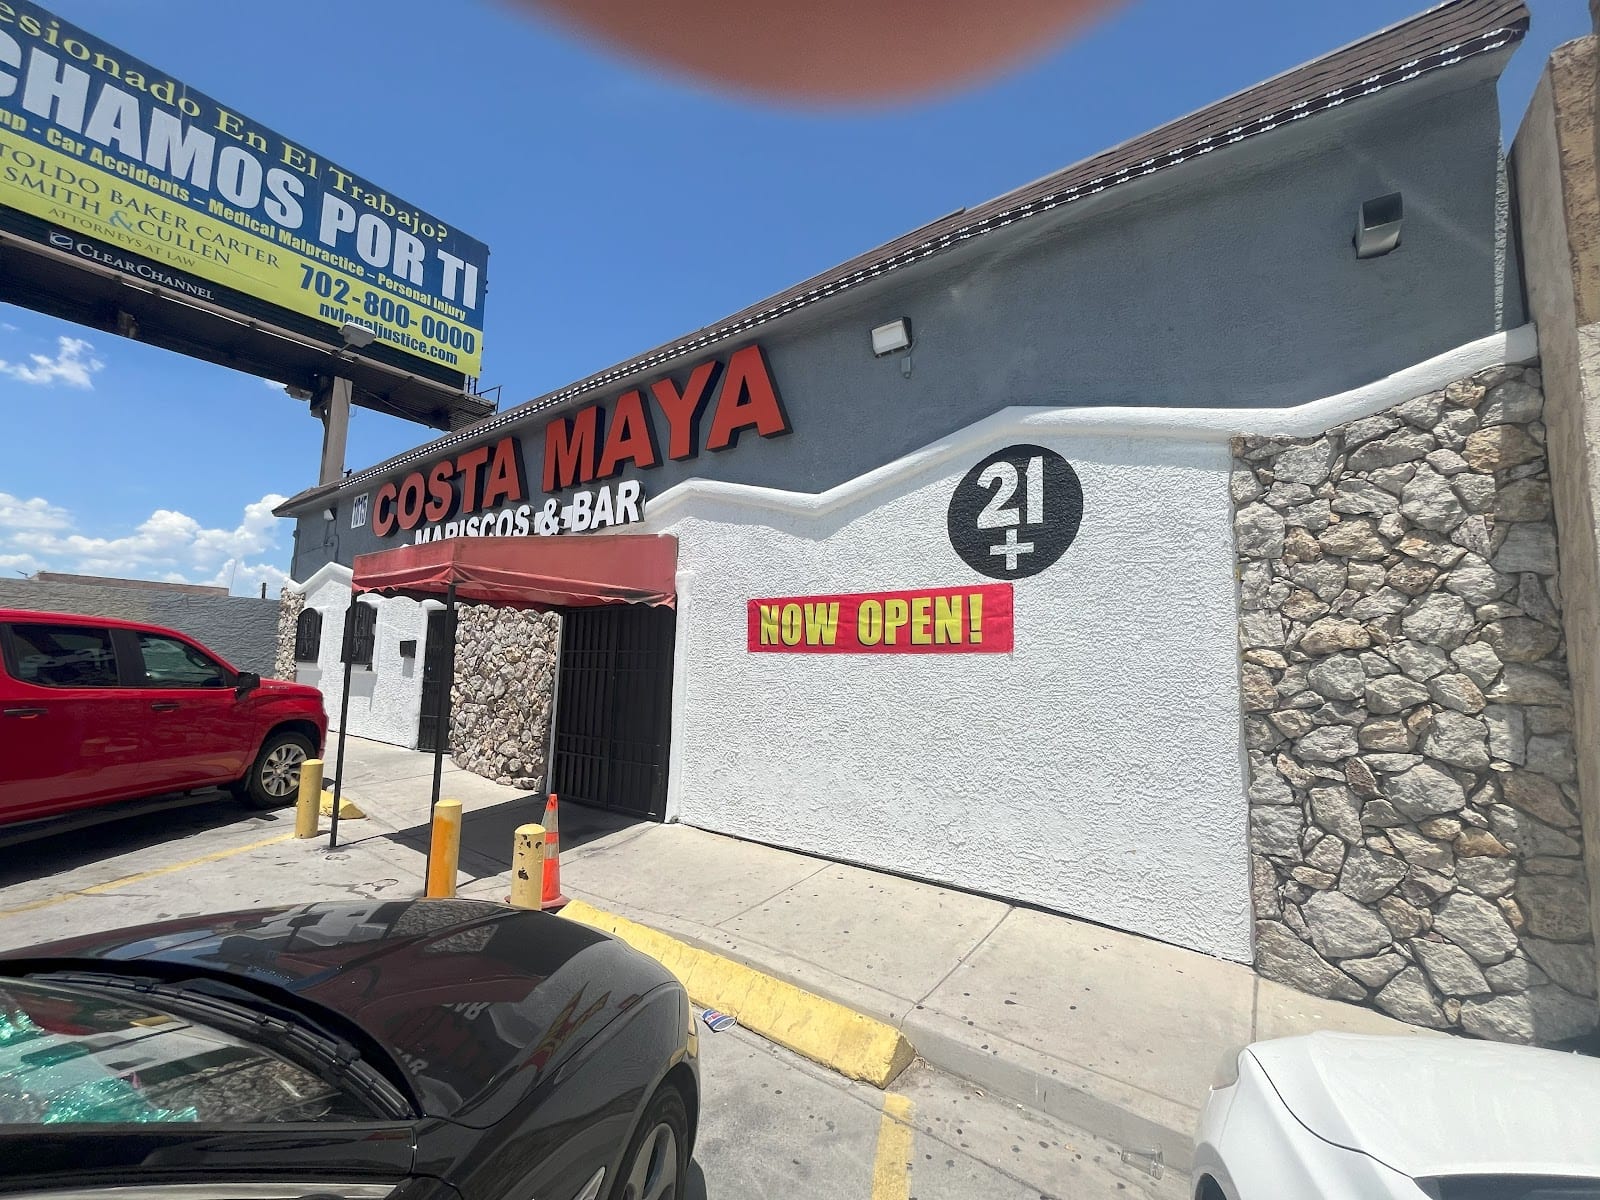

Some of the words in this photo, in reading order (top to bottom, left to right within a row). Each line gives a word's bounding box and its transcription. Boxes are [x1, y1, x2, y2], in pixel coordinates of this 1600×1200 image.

[4, 166, 100, 215] SMITH
[109, 210, 136, 234] &
[138, 220, 231, 265] CULLEN
[213, 106, 268, 154] En
[280, 141, 318, 179] El
[329, 166, 448, 243] Trabajo?
[46, 128, 86, 156] Car
[89, 147, 190, 202] Accidents
[208, 198, 275, 239] Medical
[278, 229, 365, 278] Malpractice
[378, 272, 431, 306] Personal
[433, 296, 467, 321] Injury
[48, 207, 142, 248] ATTORNEYS
[145, 244, 161, 255] AT
[167, 252, 196, 267] LAW
[110, 189, 190, 233] BAKER
[196, 226, 280, 269] CARTER
[319, 192, 425, 287] POR
[437, 248, 479, 310] TI
[299, 263, 475, 355] 702-800-0000
[372, 437, 524, 538] COSTA
[542, 344, 788, 494] MAYA
[540, 498, 561, 537] &
[571, 479, 643, 533] BAR
[976, 456, 1043, 529] 21
[759, 602, 840, 646] NOW
[857, 593, 983, 646] OPEN!
